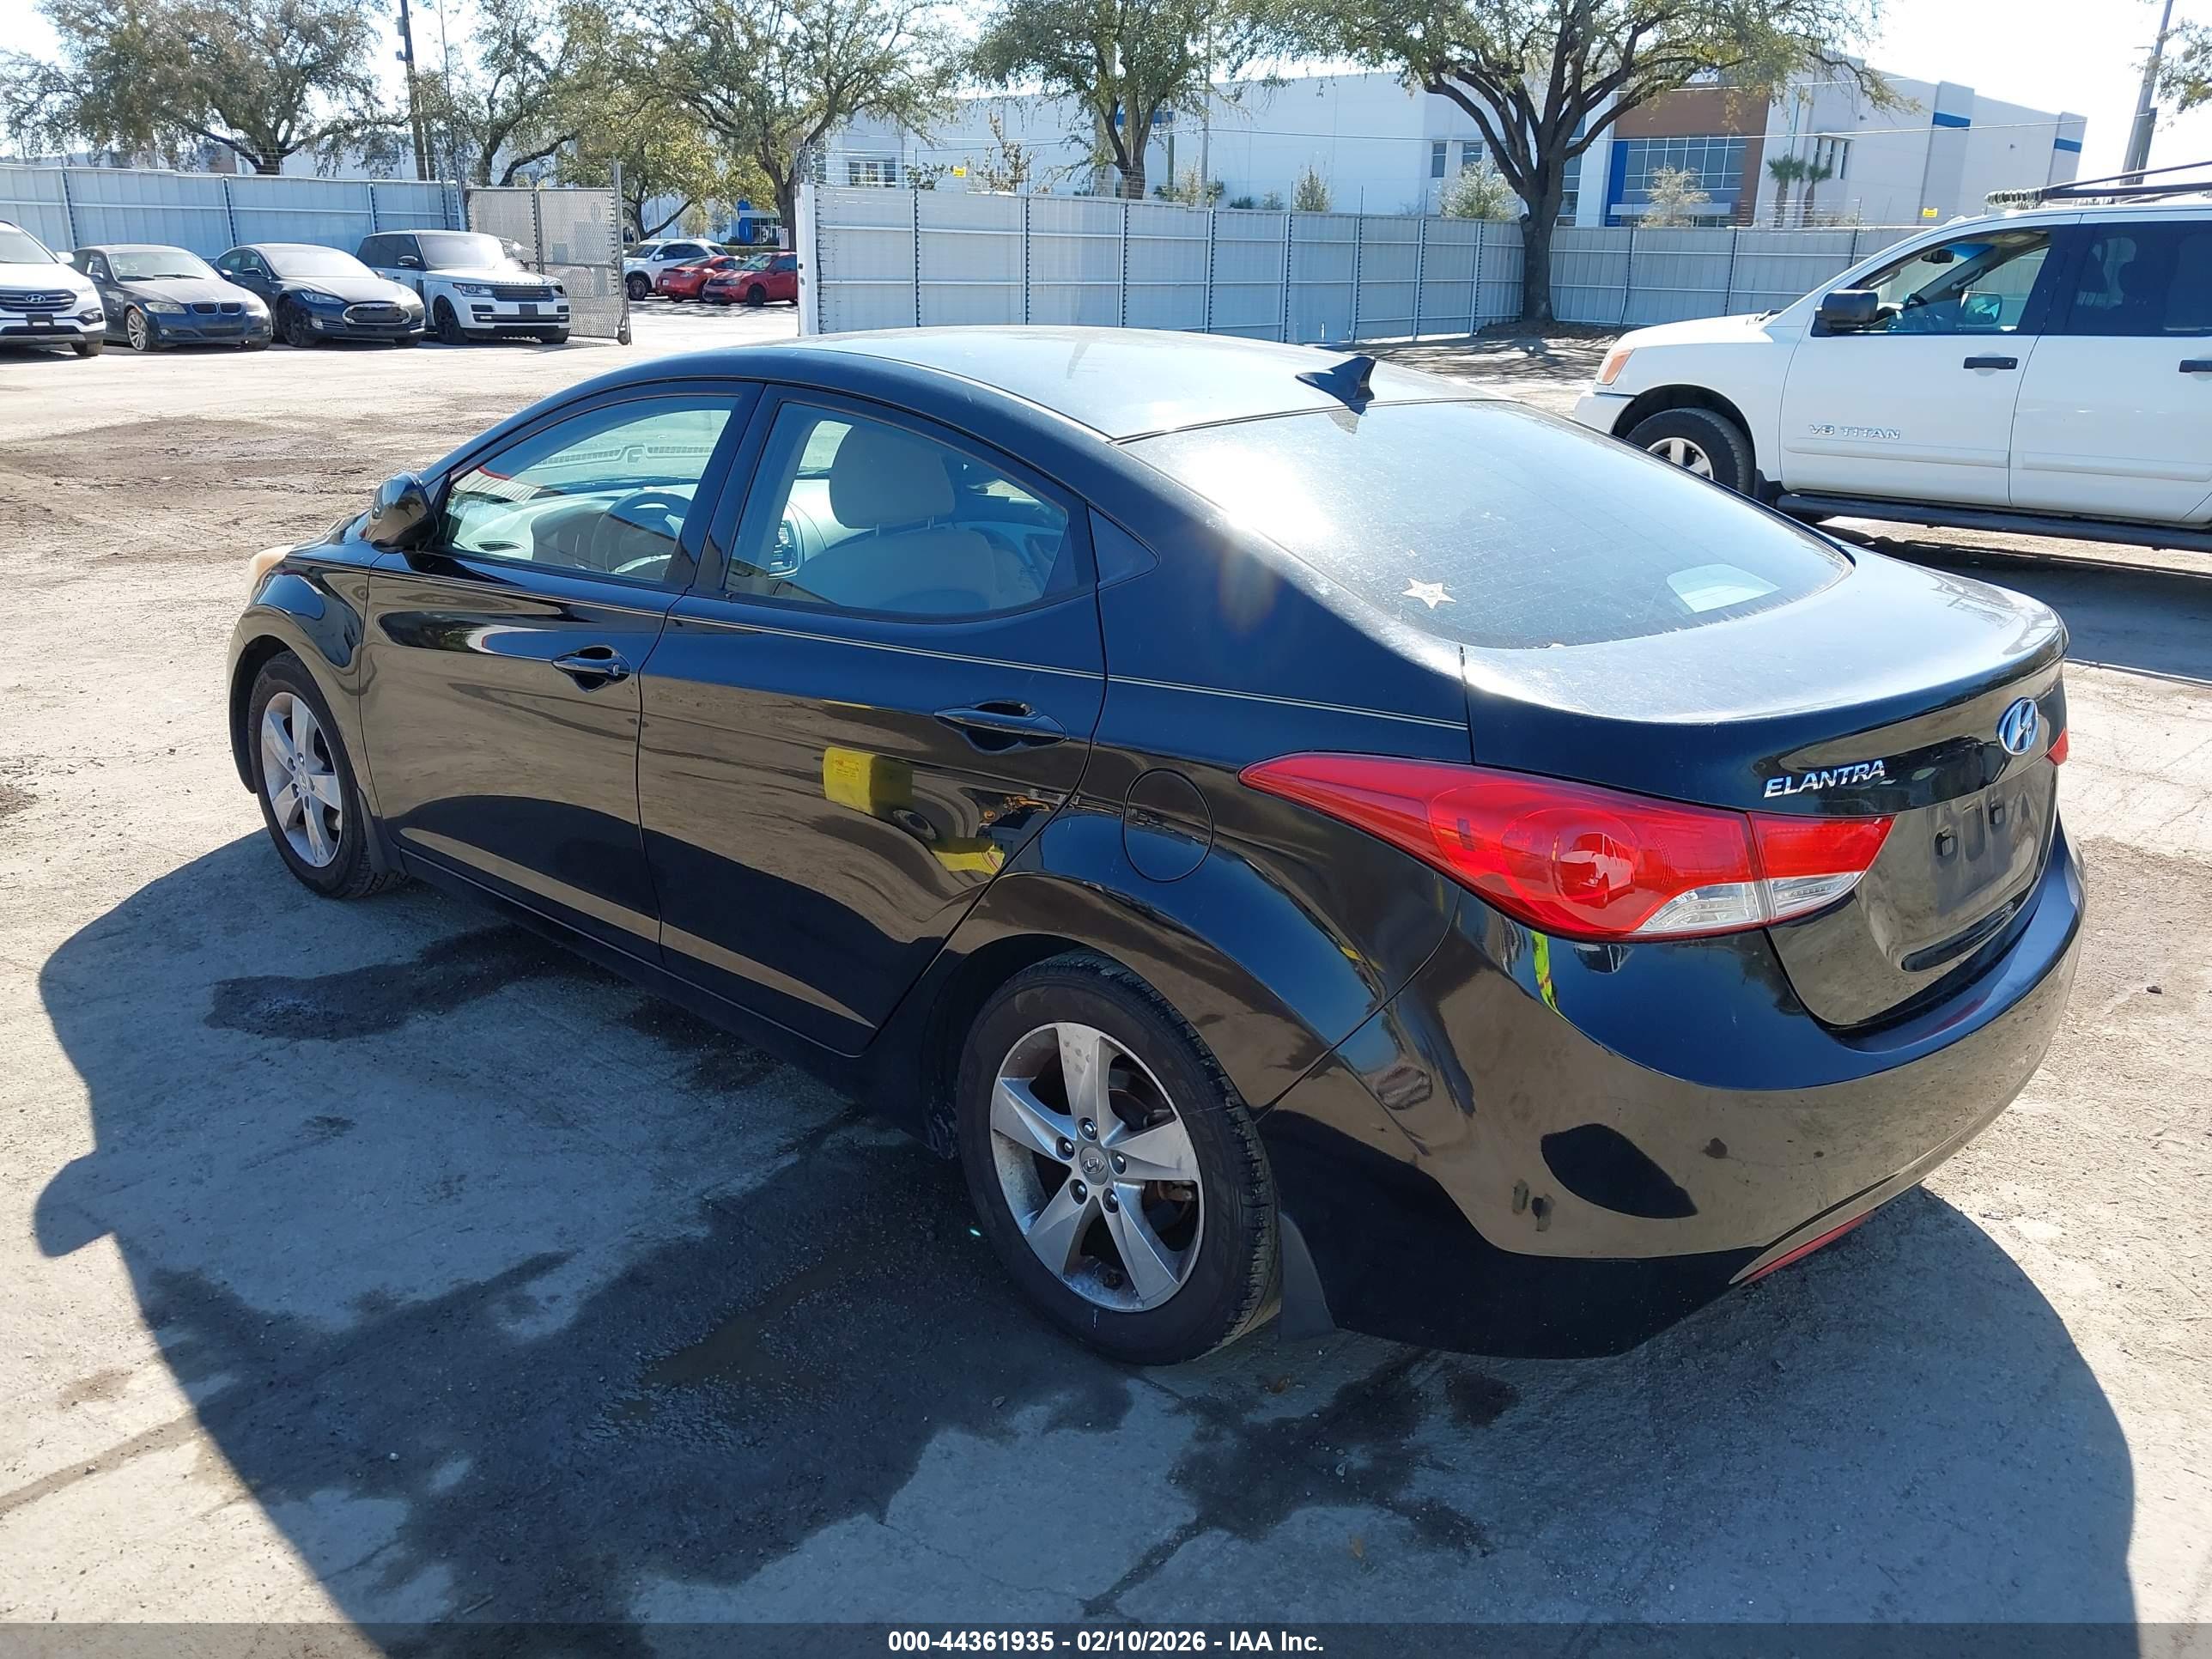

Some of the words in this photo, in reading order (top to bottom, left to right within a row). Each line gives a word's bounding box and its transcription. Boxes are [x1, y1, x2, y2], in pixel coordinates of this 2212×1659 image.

[1808, 424, 1835, 435] V8
[1840, 425, 1900, 440] TITAN
[1764, 759, 1886, 799] ELANTRA
